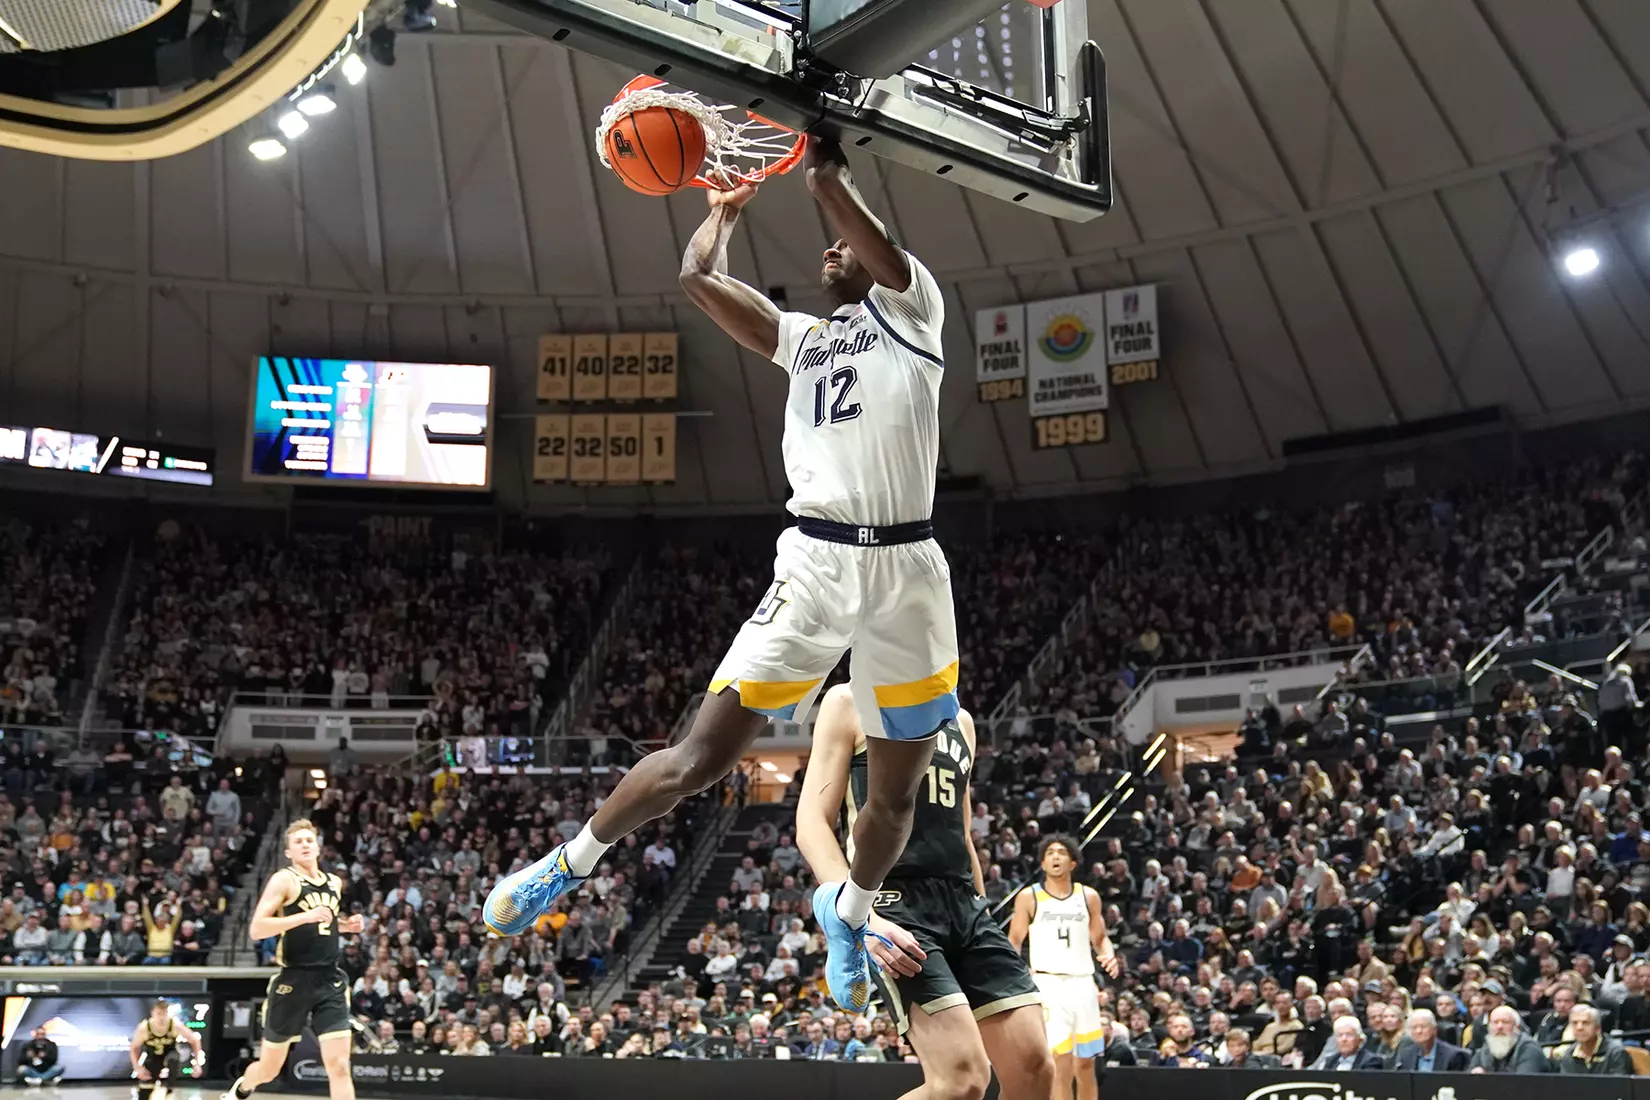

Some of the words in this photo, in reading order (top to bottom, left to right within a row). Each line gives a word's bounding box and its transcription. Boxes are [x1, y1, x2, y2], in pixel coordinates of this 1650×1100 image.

[1110, 321, 1154, 341] FINAL
[979, 339, 1022, 359] FINAL
[1114, 337, 1153, 356] FOUR
[542, 356, 567, 377] 41
[576, 356, 604, 376] 40
[612, 355, 640, 375] 22
[647, 355, 674, 375] 32
[982, 355, 1020, 374] FOUR
[1111, 361, 1158, 386] 2001
[1037, 372, 1097, 391] NATIONAL
[814, 365, 863, 427] 12
[1033, 384, 1103, 404] CHAMPIONS
[1035, 411, 1106, 448] 1999
[537, 436, 566, 457] 22
[573, 436, 602, 457] 32
[609, 436, 637, 457] 50
[654, 436, 664, 457] 1
[858, 527, 879, 545] AL
[927, 765, 956, 809] 15
[1057, 926, 1071, 948] 4
[193, 1003, 210, 1021] 7
